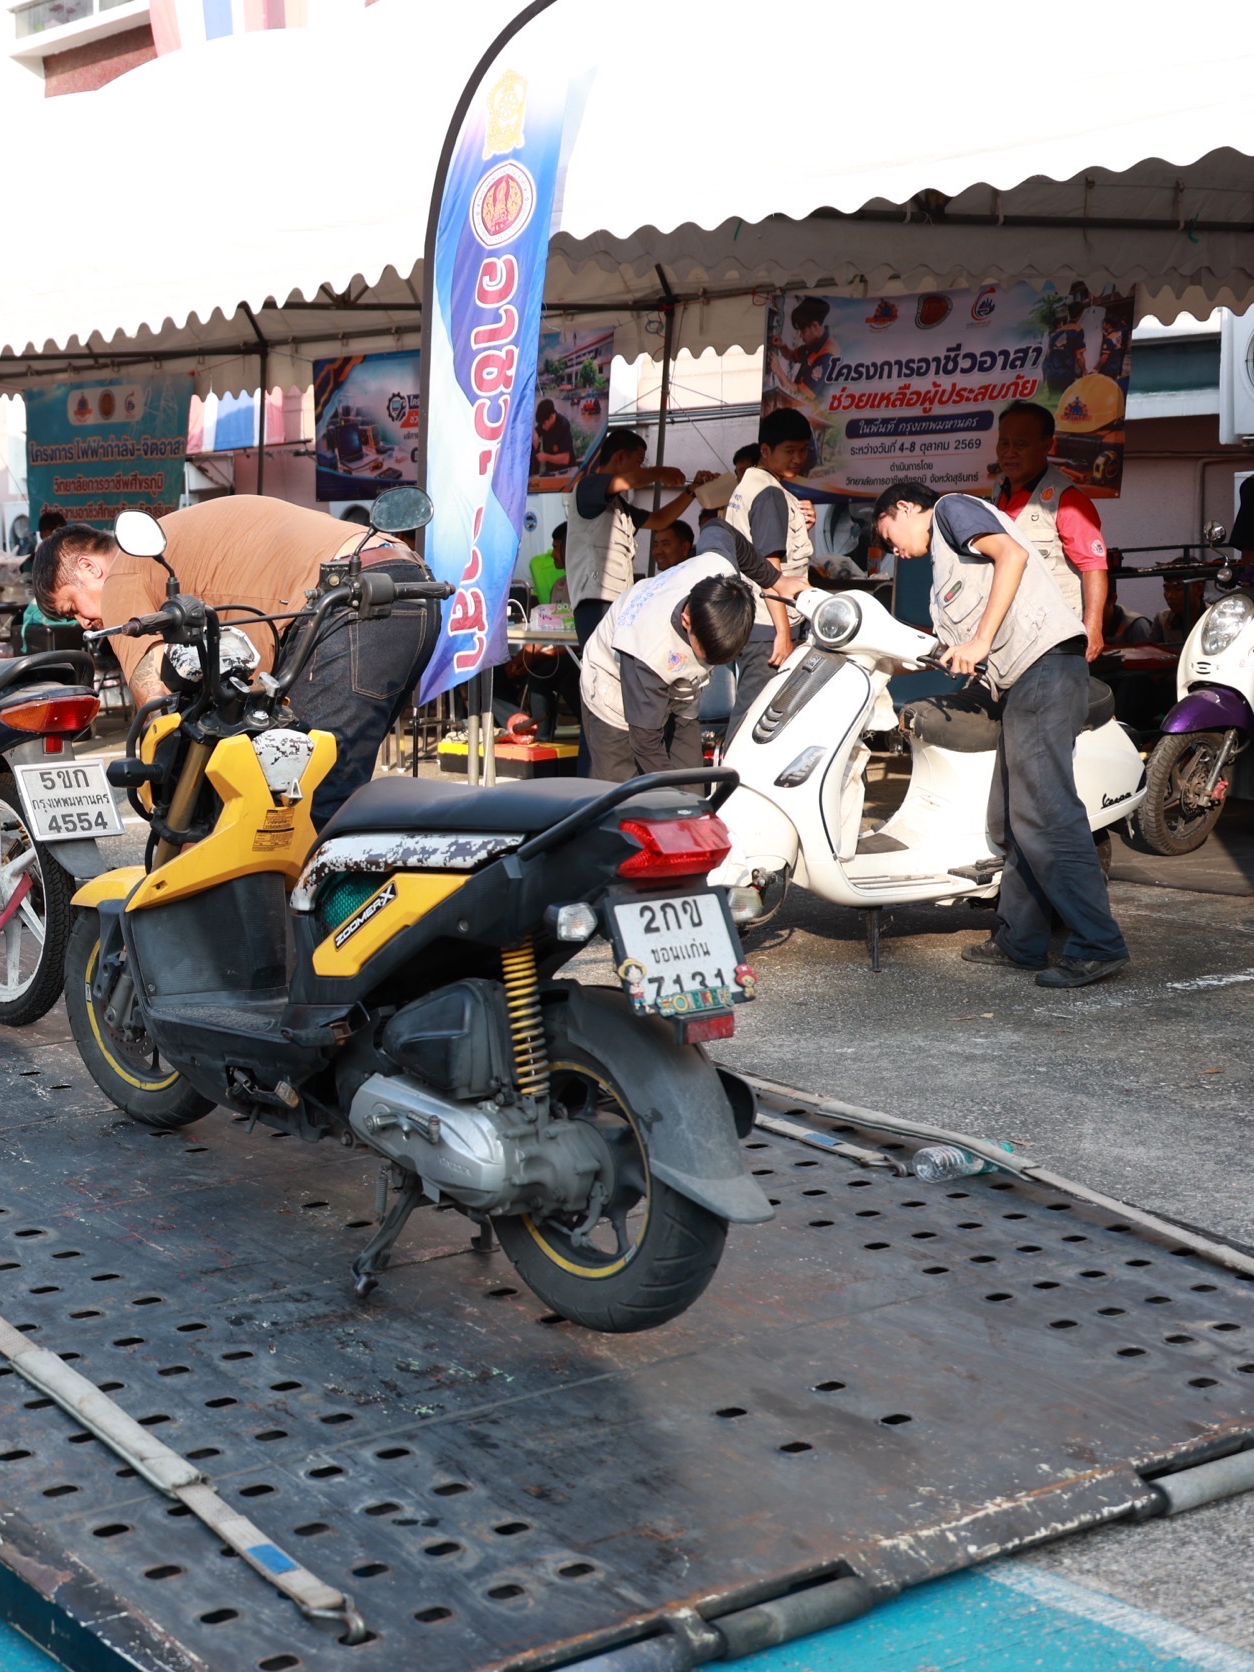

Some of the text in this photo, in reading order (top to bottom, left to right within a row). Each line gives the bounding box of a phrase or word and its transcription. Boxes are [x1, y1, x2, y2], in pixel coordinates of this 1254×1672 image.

[825, 343, 1044, 383] โครงการอาชีวอาสา
[828, 374, 1039, 414] ช่วยเหลือผู้ประสบภัย
[898, 415, 979, 436] กรุงเทพมหานคร
[850, 438, 982, 456] ระหว่างวันที่ 4-8 ตุลาคม 2569
[39, 768, 90, 790] 5ขก
[31, 793, 111, 813] กรุงเทพมหานคร
[1100, 792, 1133, 809] Vespa
[48, 811, 108, 834] 4554
[335, 884, 396, 947] ZOOMER-X
[639, 899, 703, 934] 2กข
[651, 938, 711, 963] ขอนแก่น
